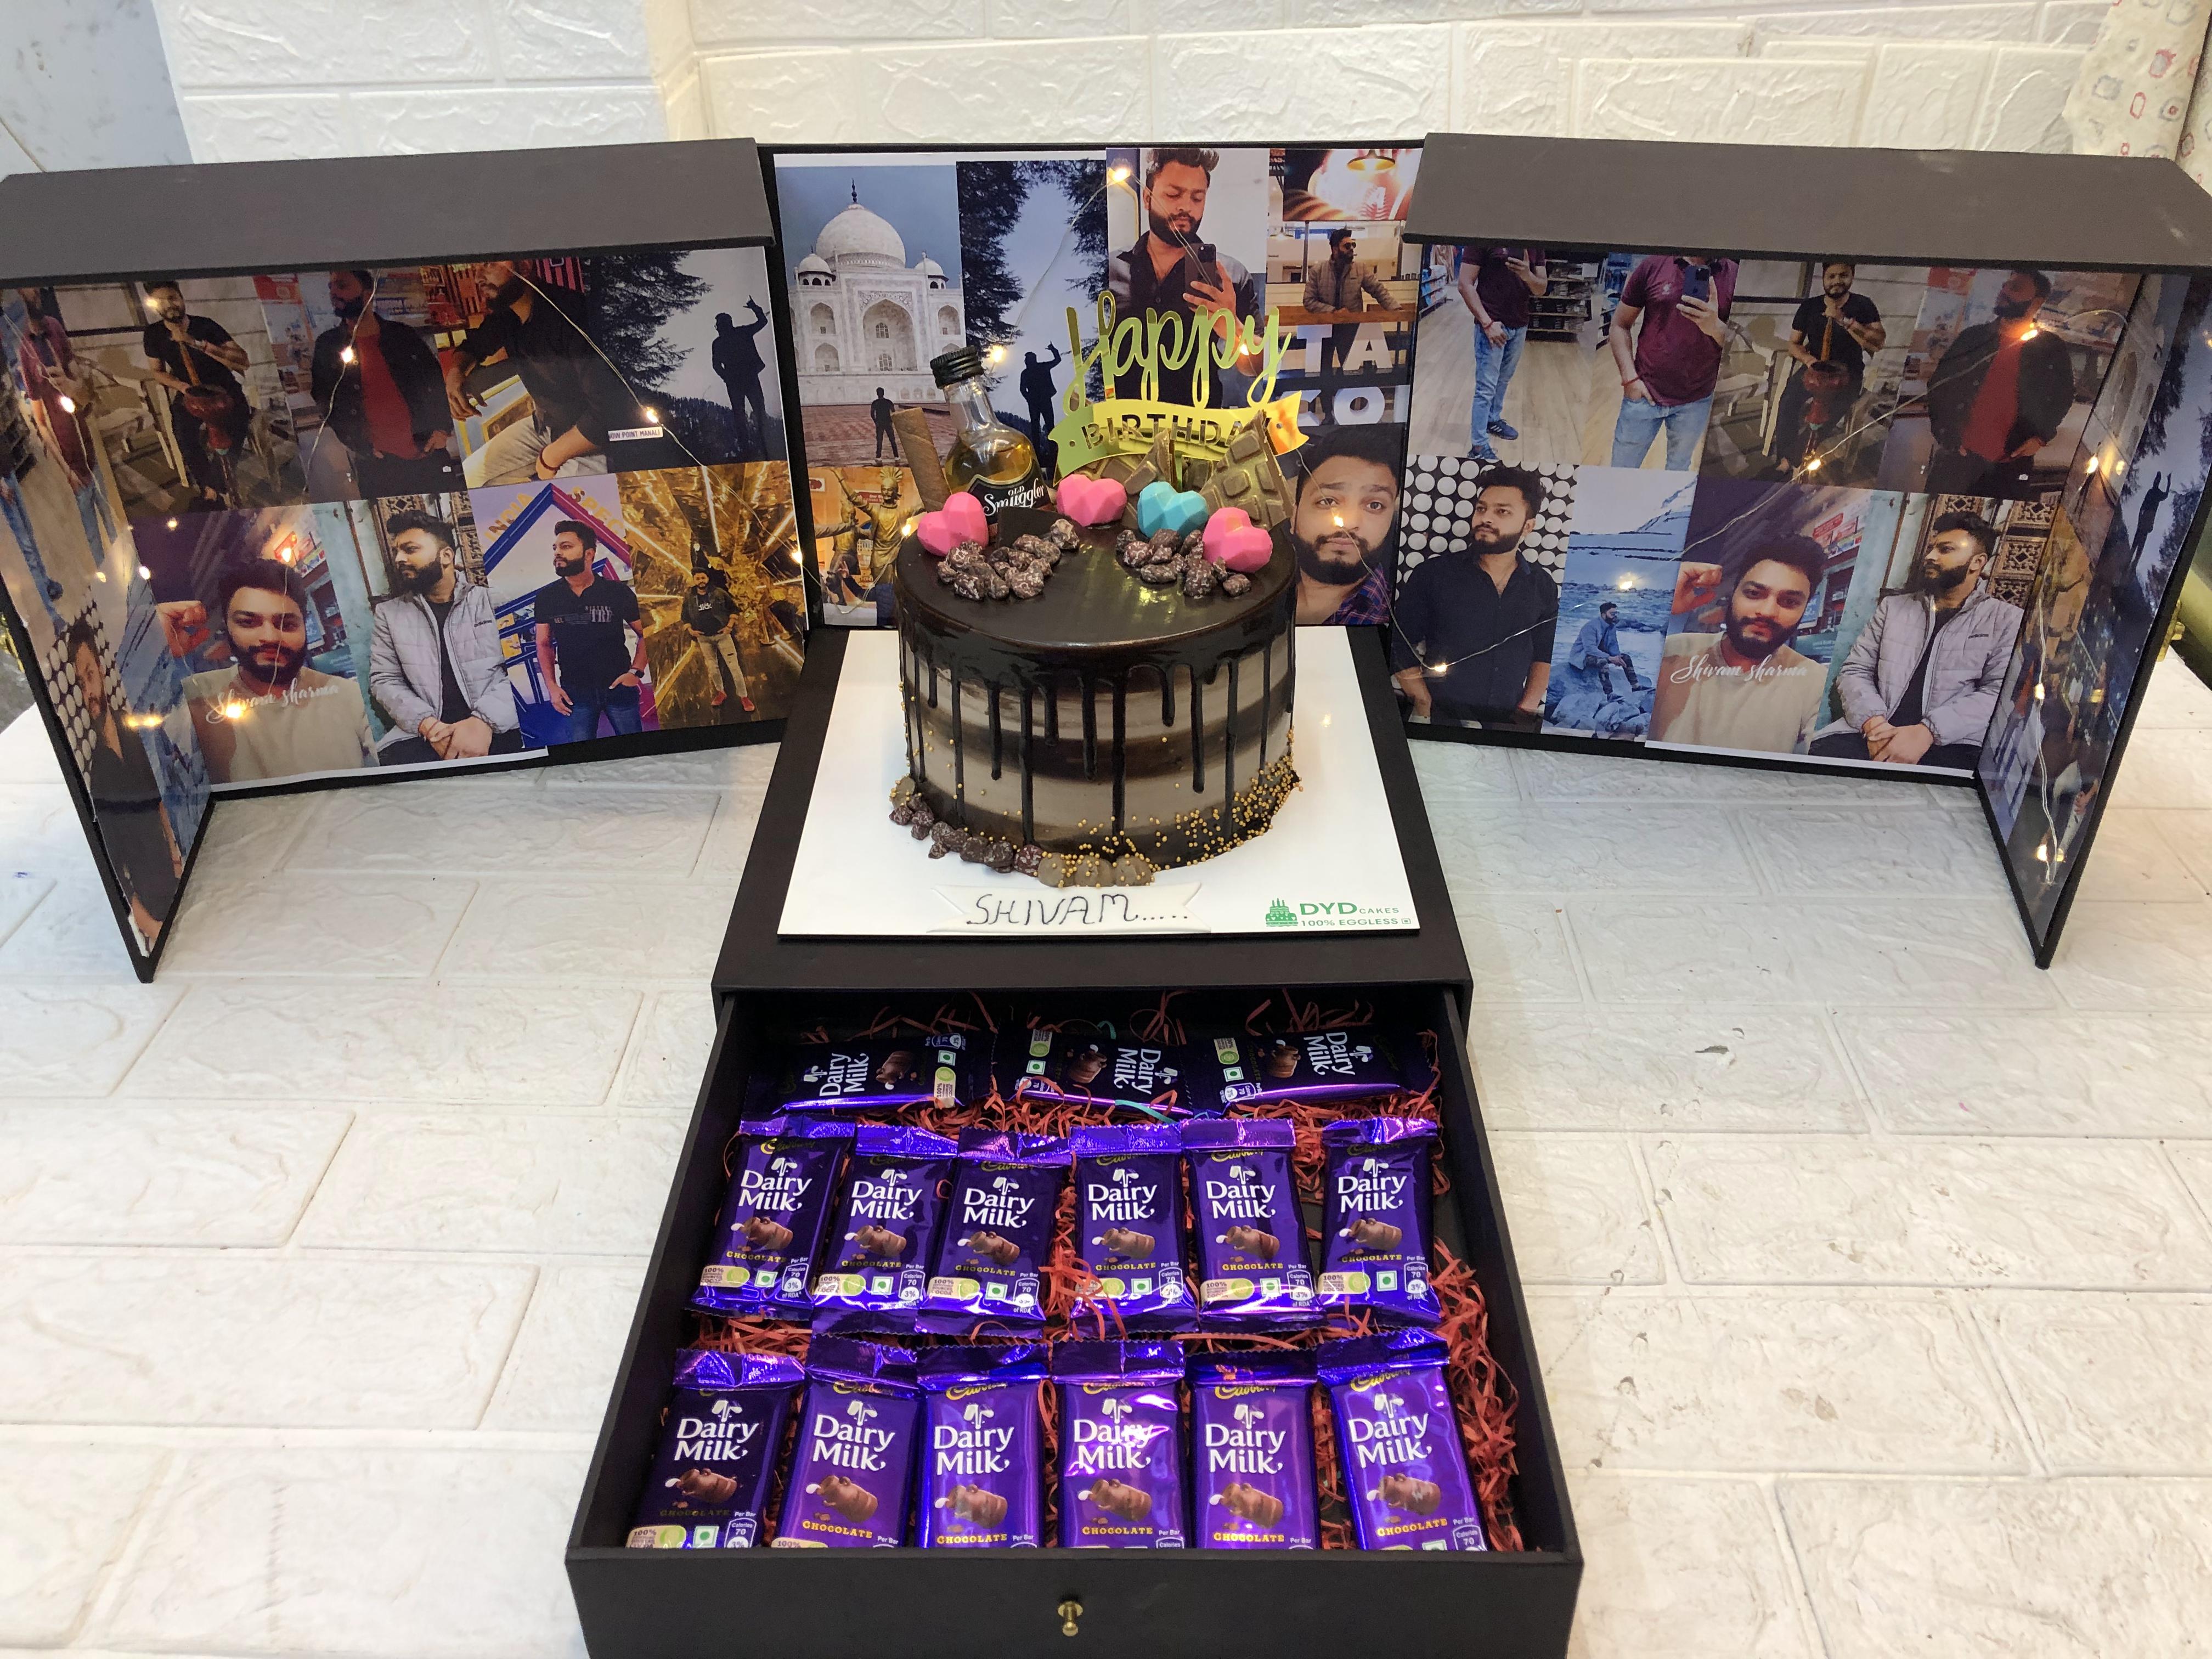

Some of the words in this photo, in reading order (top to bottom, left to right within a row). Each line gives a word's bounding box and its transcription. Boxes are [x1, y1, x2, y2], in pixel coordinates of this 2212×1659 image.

[1063, 290, 1291, 416] Happy
[983, 477, 1045, 516] Smuggler
[1008, 486, 1025, 496] OLD
[1299, 902, 1358, 916] DYD
[1304, 1036, 1333, 1075] Milk
[1325, 1031, 1356, 1075] Dairy
[819, 1053, 851, 1097] Dairy
[843, 1053, 870, 1092] Milk
[1114, 1047, 1138, 1089] Milk
[1131, 1048, 1161, 1095] Dairy
[741, 1170, 812, 1196] Dairy
[851, 1181, 922, 1206] Dairy
[1088, 1184, 1157, 1204] Dairy
[1206, 1181, 1276, 1203] Dairy
[1338, 1176, 1407, 1194] Dairy
[738, 1189, 802, 1211] Milk
[851, 1200, 914, 1220] Milk
[963, 1188, 1035, 1214] Dairy
[1092, 1203, 1155, 1221] Milk
[1211, 1200, 1276, 1219] Milk
[1340, 1193, 1403, 1212] Milk
[963, 1207, 1027, 1228] Milk
[955, 1265, 1016, 1276] CHOCOLATE
[1096, 1262, 1156, 1271] CHOCOLATE
[1341, 1254, 1402, 1263] CHOCOLATE
[677, 1418, 760, 1443] Dairy
[814, 1414, 895, 1452] Dairy
[934, 1426, 1014, 1452] Dairy
[1206, 1424, 1286, 1454] Dairy
[1348, 1413, 1429, 1443] Dairy
[674, 1441, 748, 1461] Milk
[813, 1440, 886, 1471] Milk
[937, 1451, 1010, 1475] Milk
[1078, 1444, 1151, 1469] Milk
[1210, 1449, 1283, 1474] Milk
[1357, 1437, 1432, 1469] Milk
[802, 1520, 873, 1538] CHOCOLATE
[937, 1534, 1007, 1544] CHOCOLATE
[1082, 1527, 1153, 1535] CHOCOLATE
[1214, 1532, 1285, 1542] CHOCOLATE
[1377, 1519, 1448, 1537] CHOCOLATE
